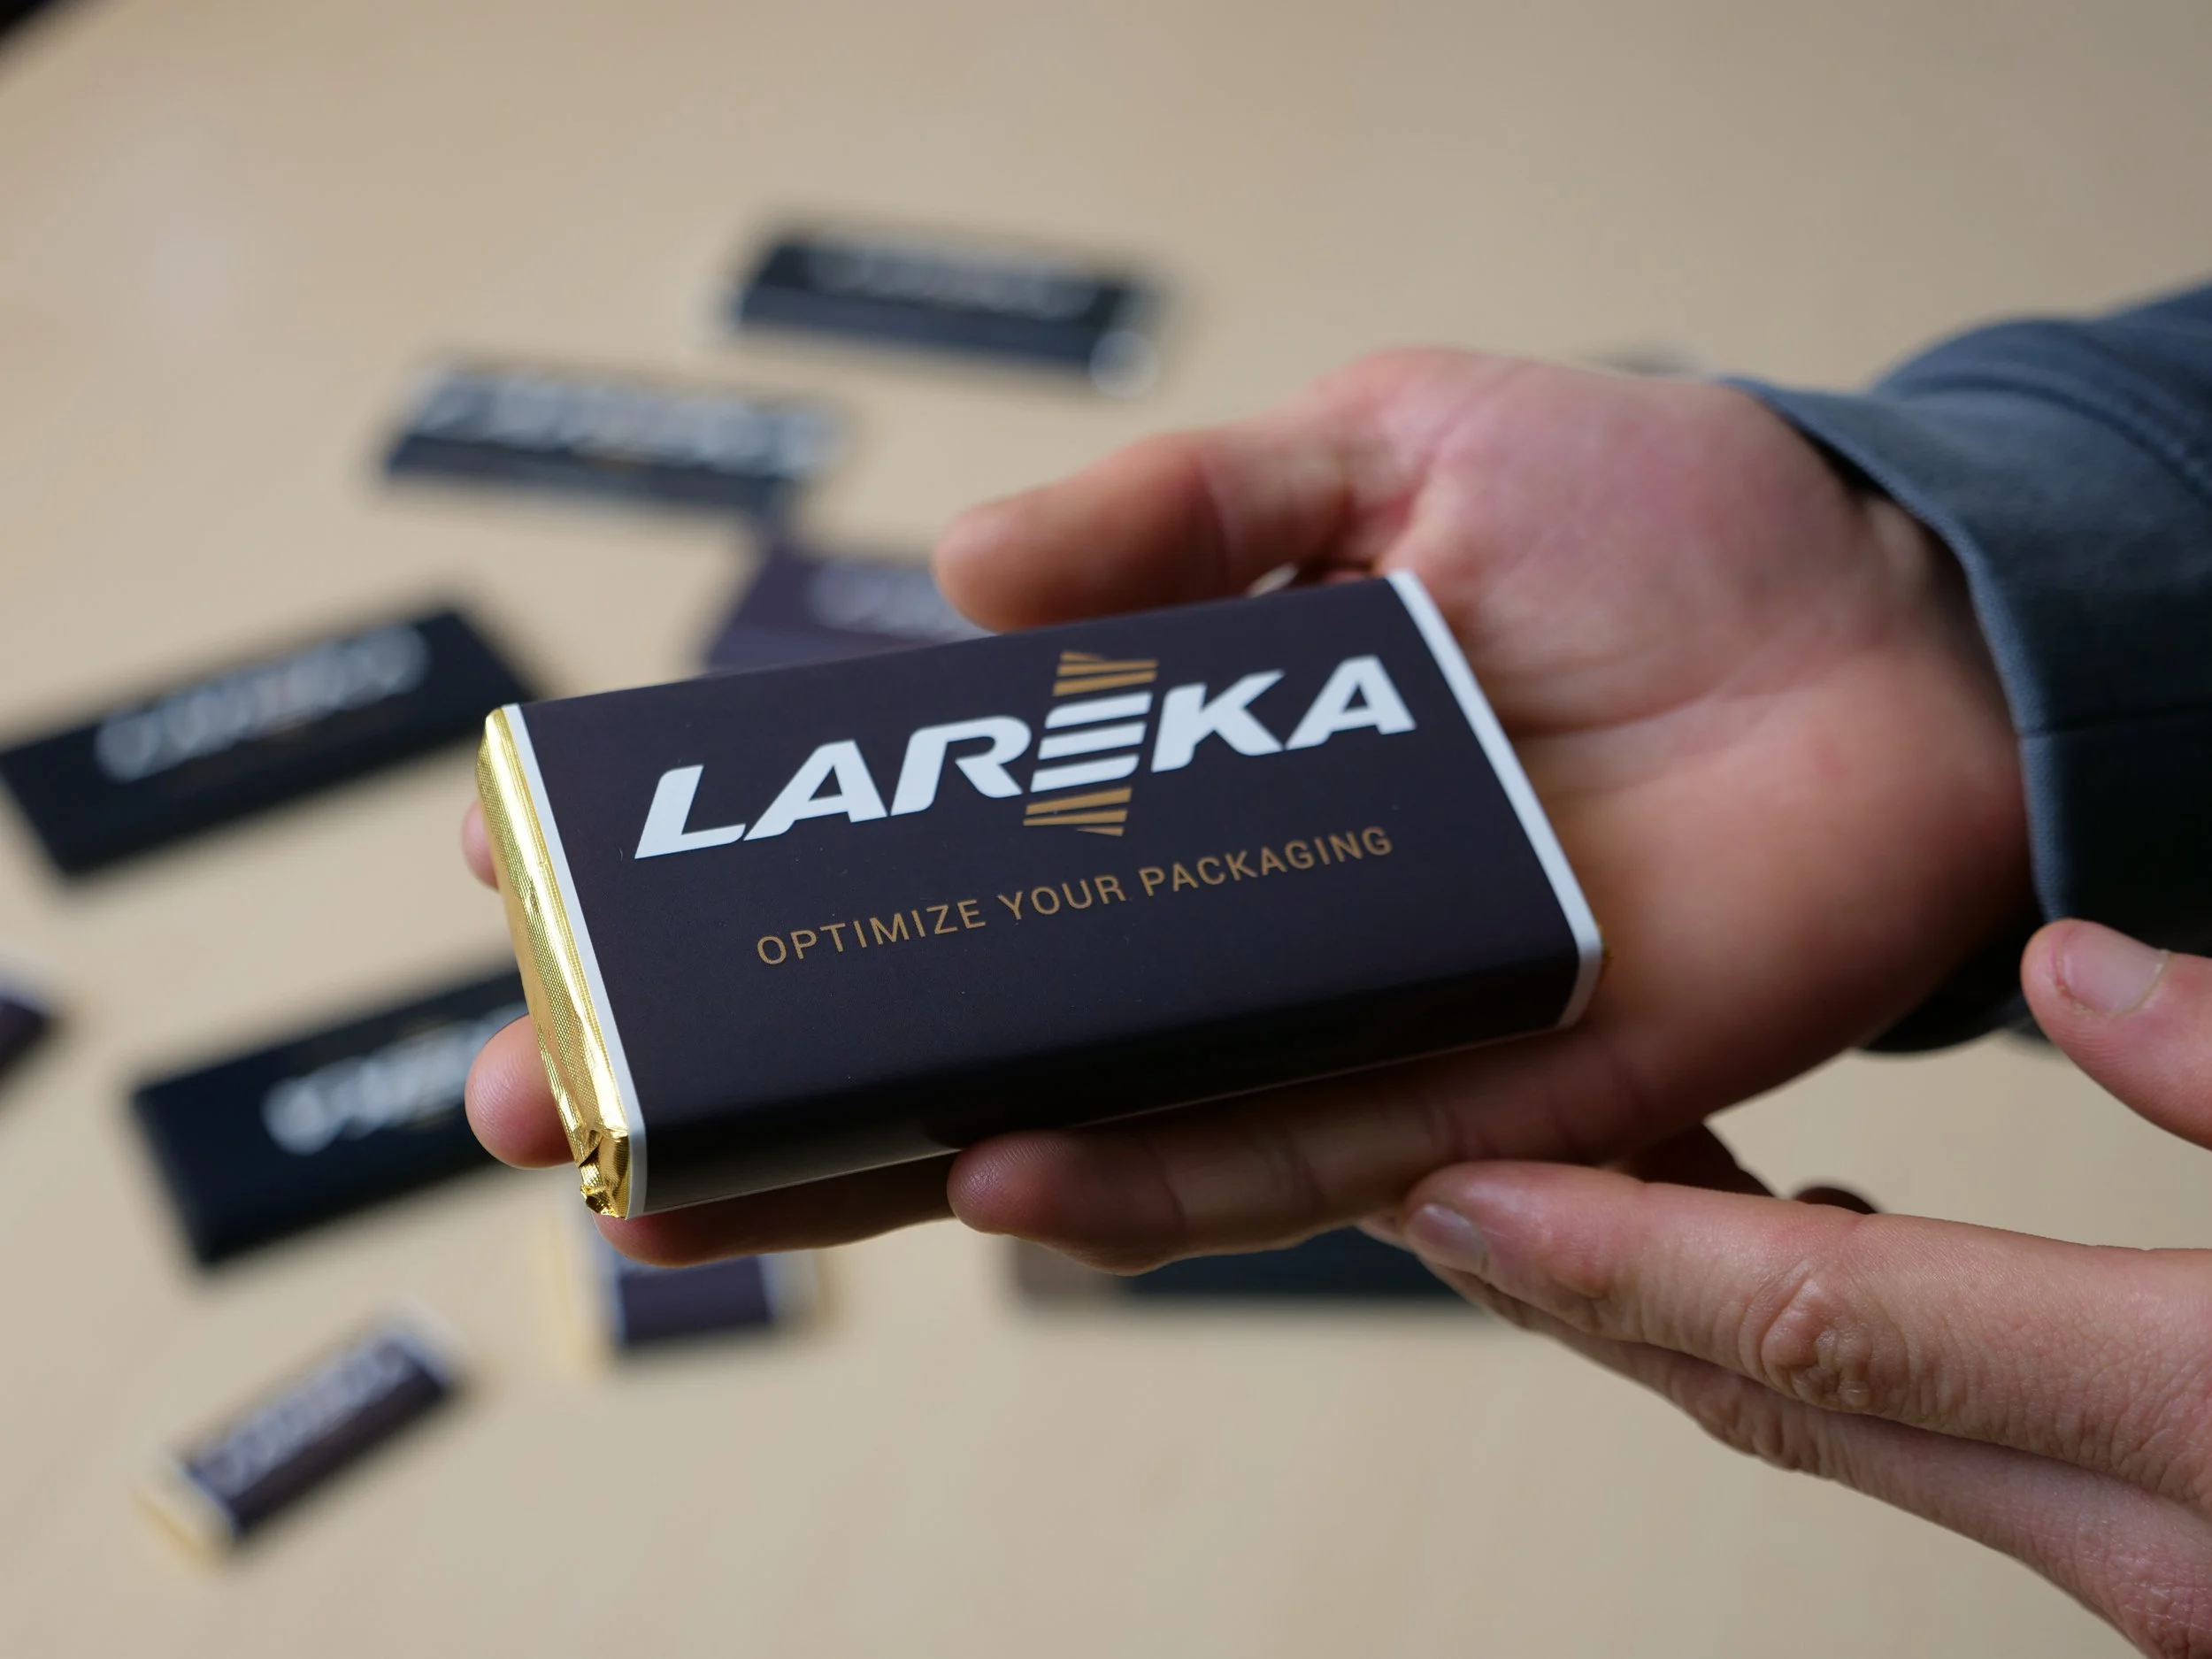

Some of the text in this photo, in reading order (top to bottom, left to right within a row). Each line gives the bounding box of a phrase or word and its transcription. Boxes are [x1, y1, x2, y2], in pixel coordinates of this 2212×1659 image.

[634, 655, 1417, 859] LAREKA
[756, 824, 1394, 966] OPTIMIZE YOUR PACKAGING
